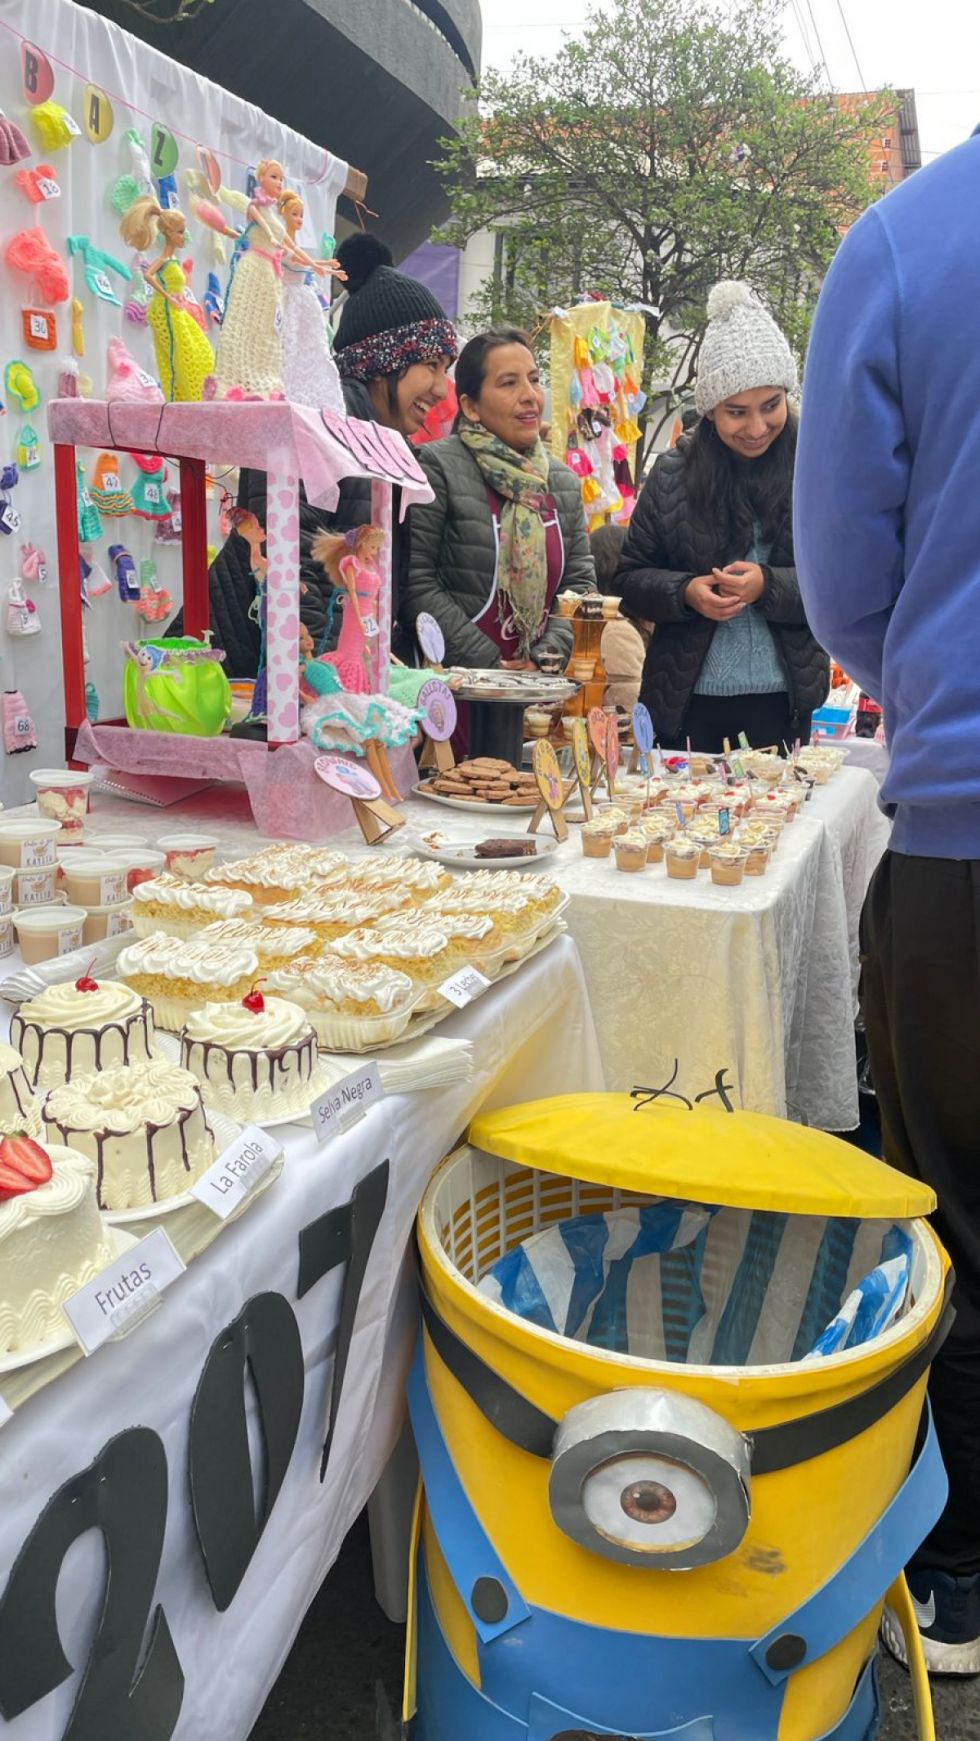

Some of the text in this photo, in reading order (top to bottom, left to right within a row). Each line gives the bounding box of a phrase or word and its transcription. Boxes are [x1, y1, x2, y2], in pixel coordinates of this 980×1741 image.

[17, 719, 30, 732] 68
[340, 1075, 373, 1104] Negra
[209, 1139, 264, 1195] La Farola
[94, 1261, 152, 1316] Frutas
[0, 1157, 390, 1741] 207
